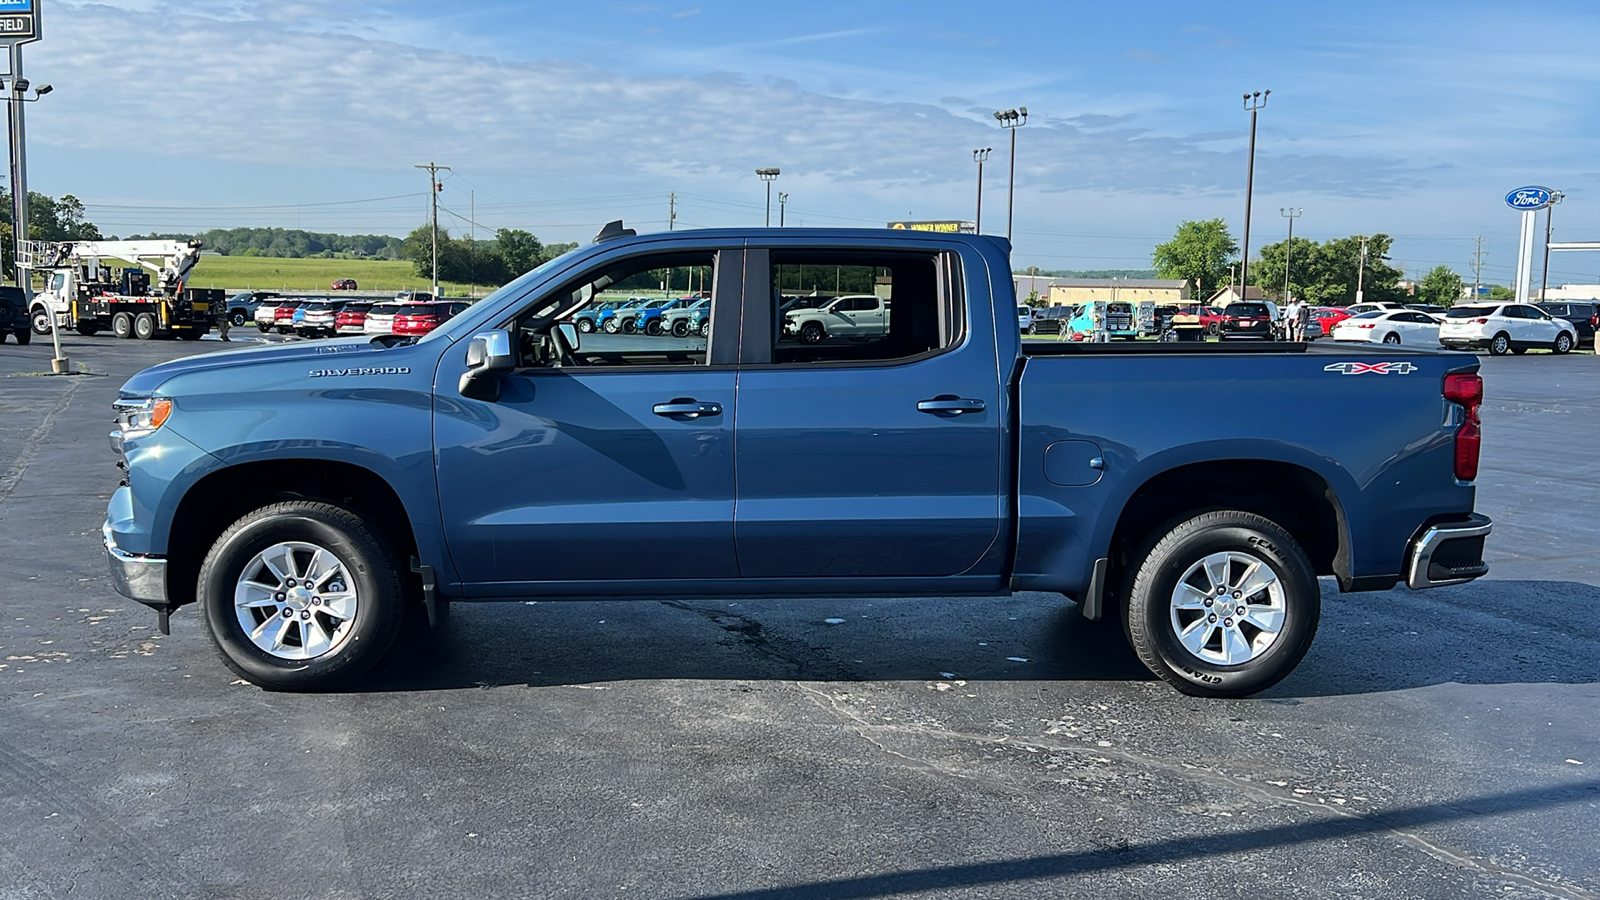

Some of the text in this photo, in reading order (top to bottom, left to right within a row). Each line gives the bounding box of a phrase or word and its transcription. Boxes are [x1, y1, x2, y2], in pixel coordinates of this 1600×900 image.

[1513, 191, 1544, 206] Ford
[934, 223, 959, 233] WINNER
[309, 366, 411, 377] SILVERADO
